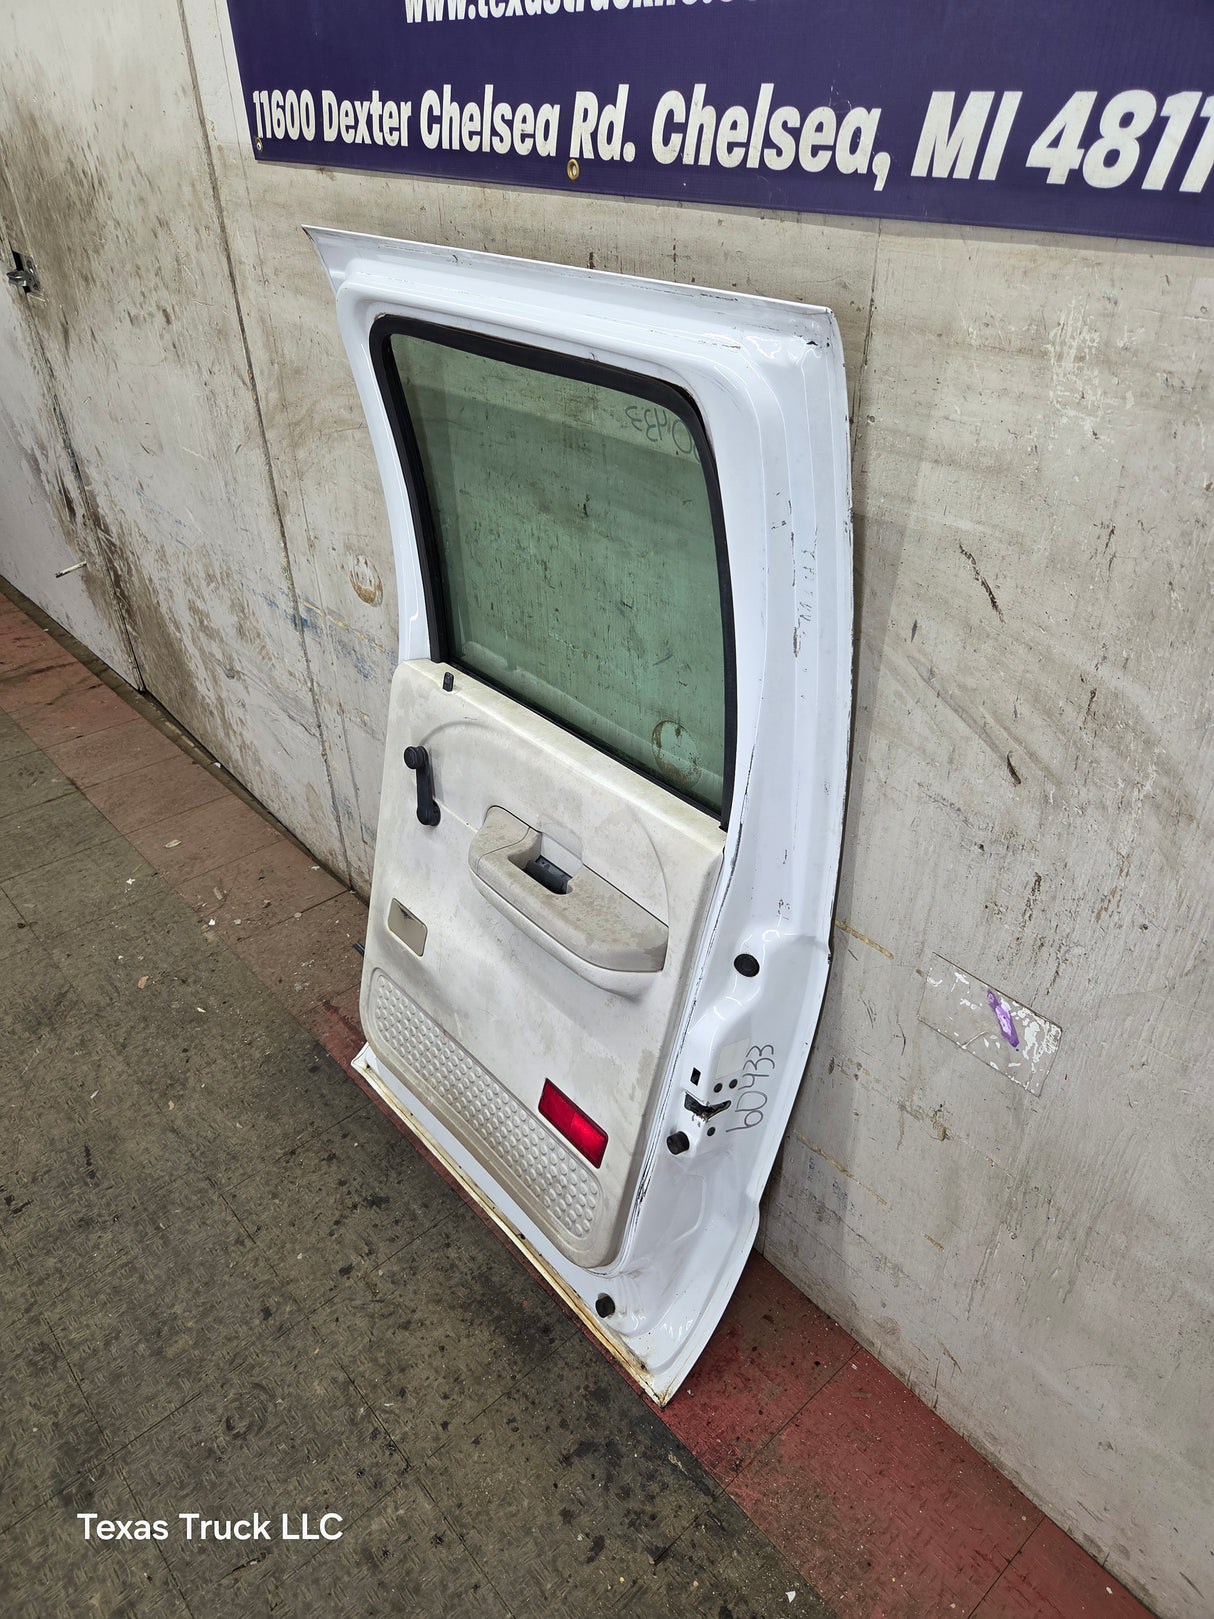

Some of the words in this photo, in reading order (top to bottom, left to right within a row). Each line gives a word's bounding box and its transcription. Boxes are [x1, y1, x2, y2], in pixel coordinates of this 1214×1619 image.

[253, 89, 316, 141] 11600
[321, 90, 412, 147] Dexter
[419, 84, 560, 156] Chelsea
[569, 83, 635, 162] Rd.
[651, 83, 891, 192] Chelsea,
[910, 91, 1022, 181] MI
